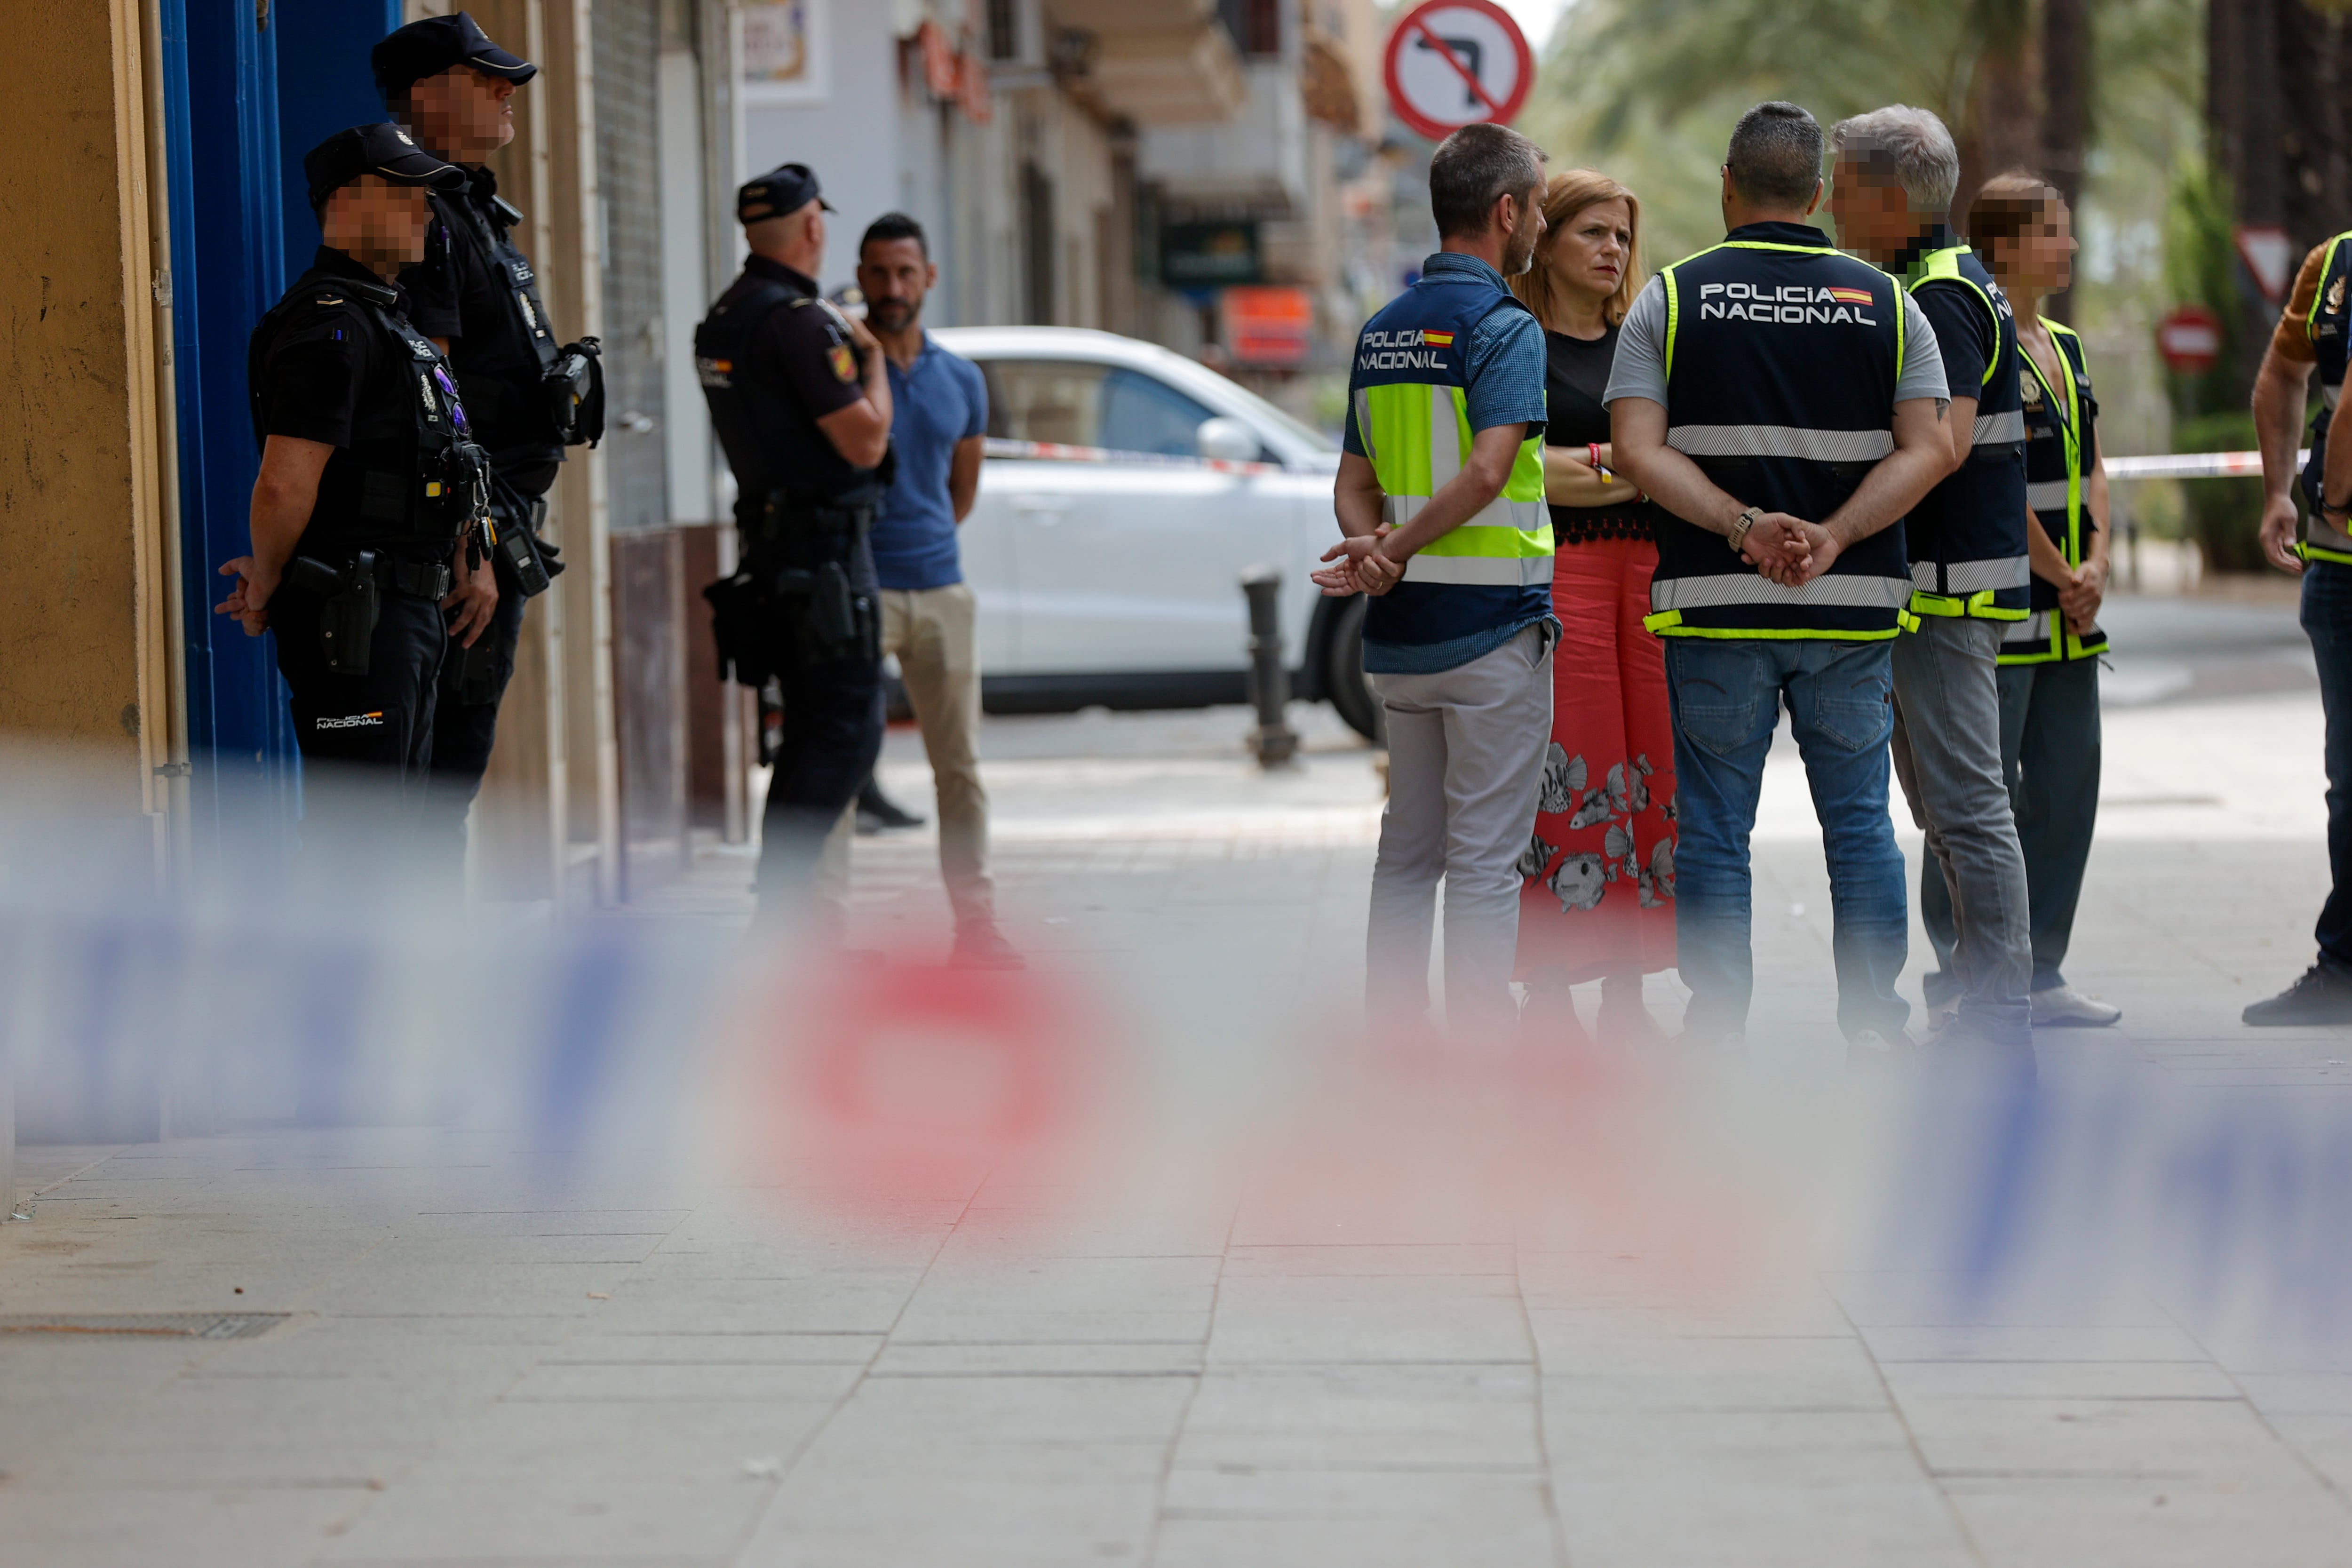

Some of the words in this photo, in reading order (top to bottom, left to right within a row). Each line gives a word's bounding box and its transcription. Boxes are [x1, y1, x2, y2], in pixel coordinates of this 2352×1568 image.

[1700, 301, 1877, 326] NACIONAL
[1358, 350, 1448, 371] NACIONAL
[317, 717, 383, 730] NACIONAL
